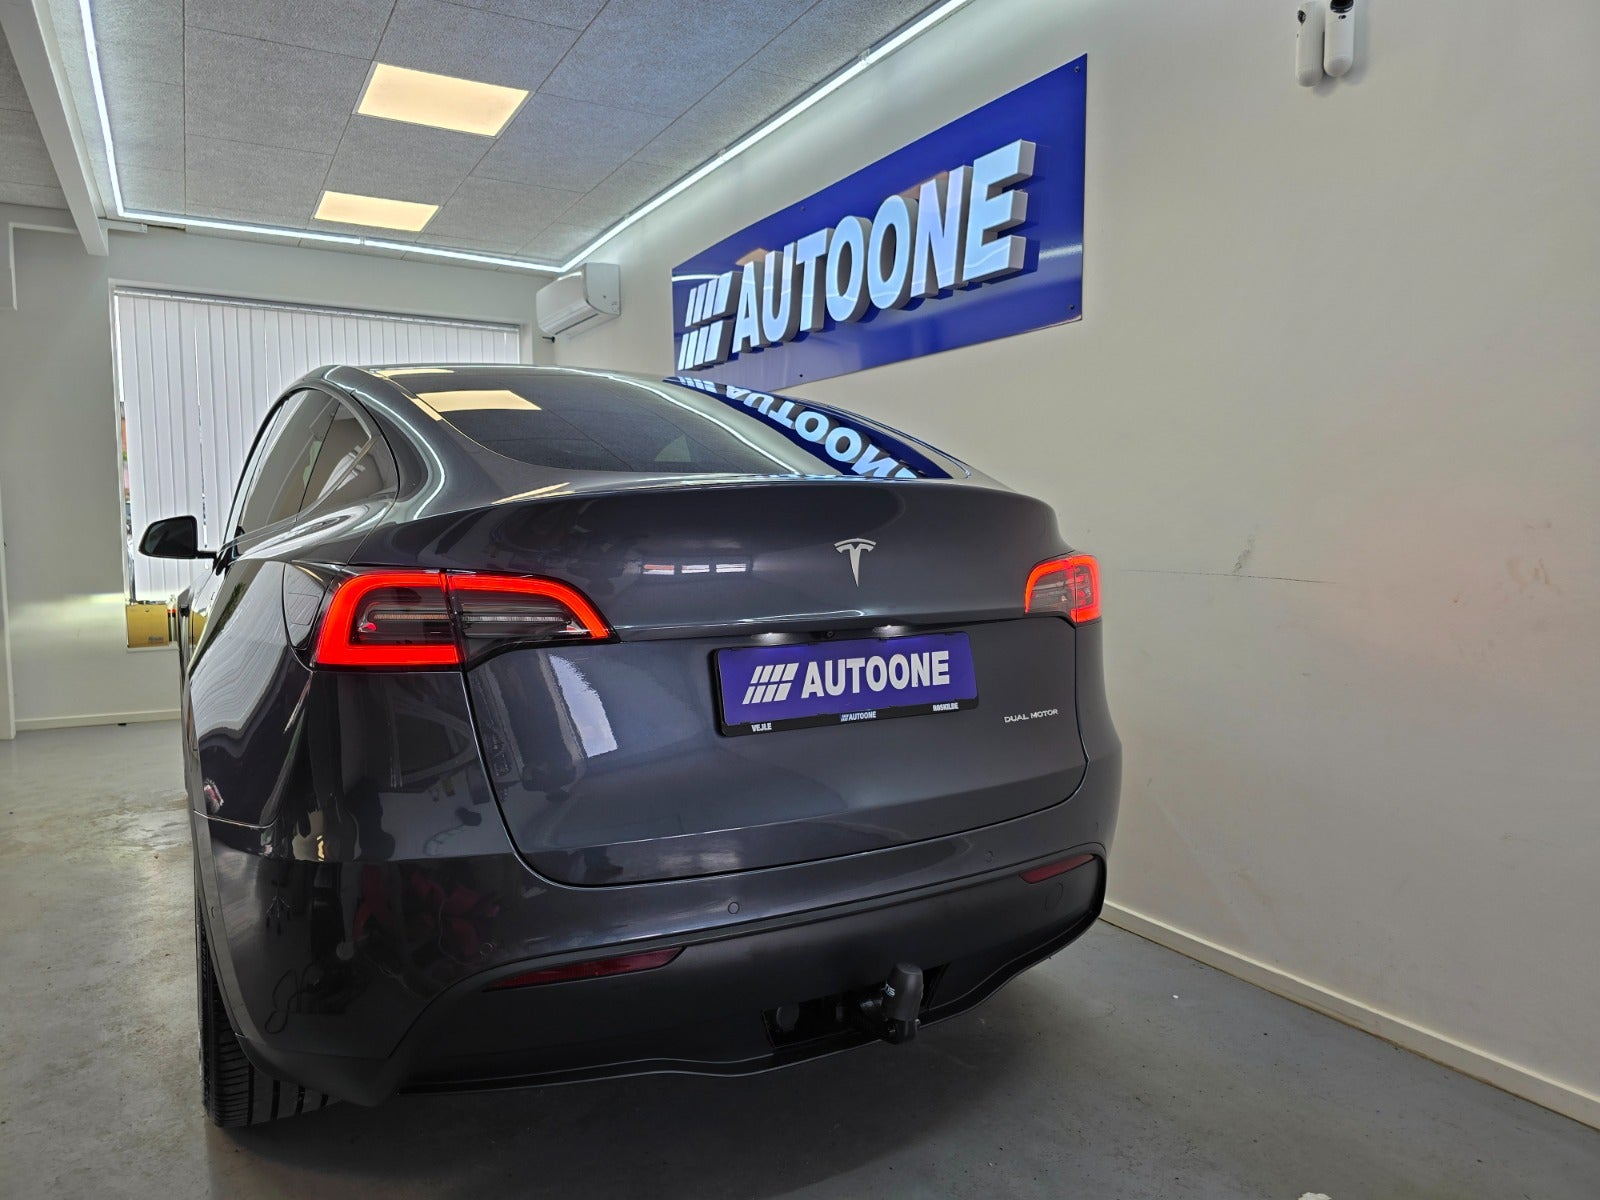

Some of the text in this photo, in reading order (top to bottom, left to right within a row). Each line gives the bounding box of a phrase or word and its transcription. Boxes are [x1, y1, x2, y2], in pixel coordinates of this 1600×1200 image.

[732, 139, 1035, 354] AUTOONE
[800, 650, 950, 699] AUTOONE
[848, 711, 877, 721] AUTOONE
[1003, 708, 1059, 723] DUAL MOTOR
[751, 722, 773, 732] VEJLE
